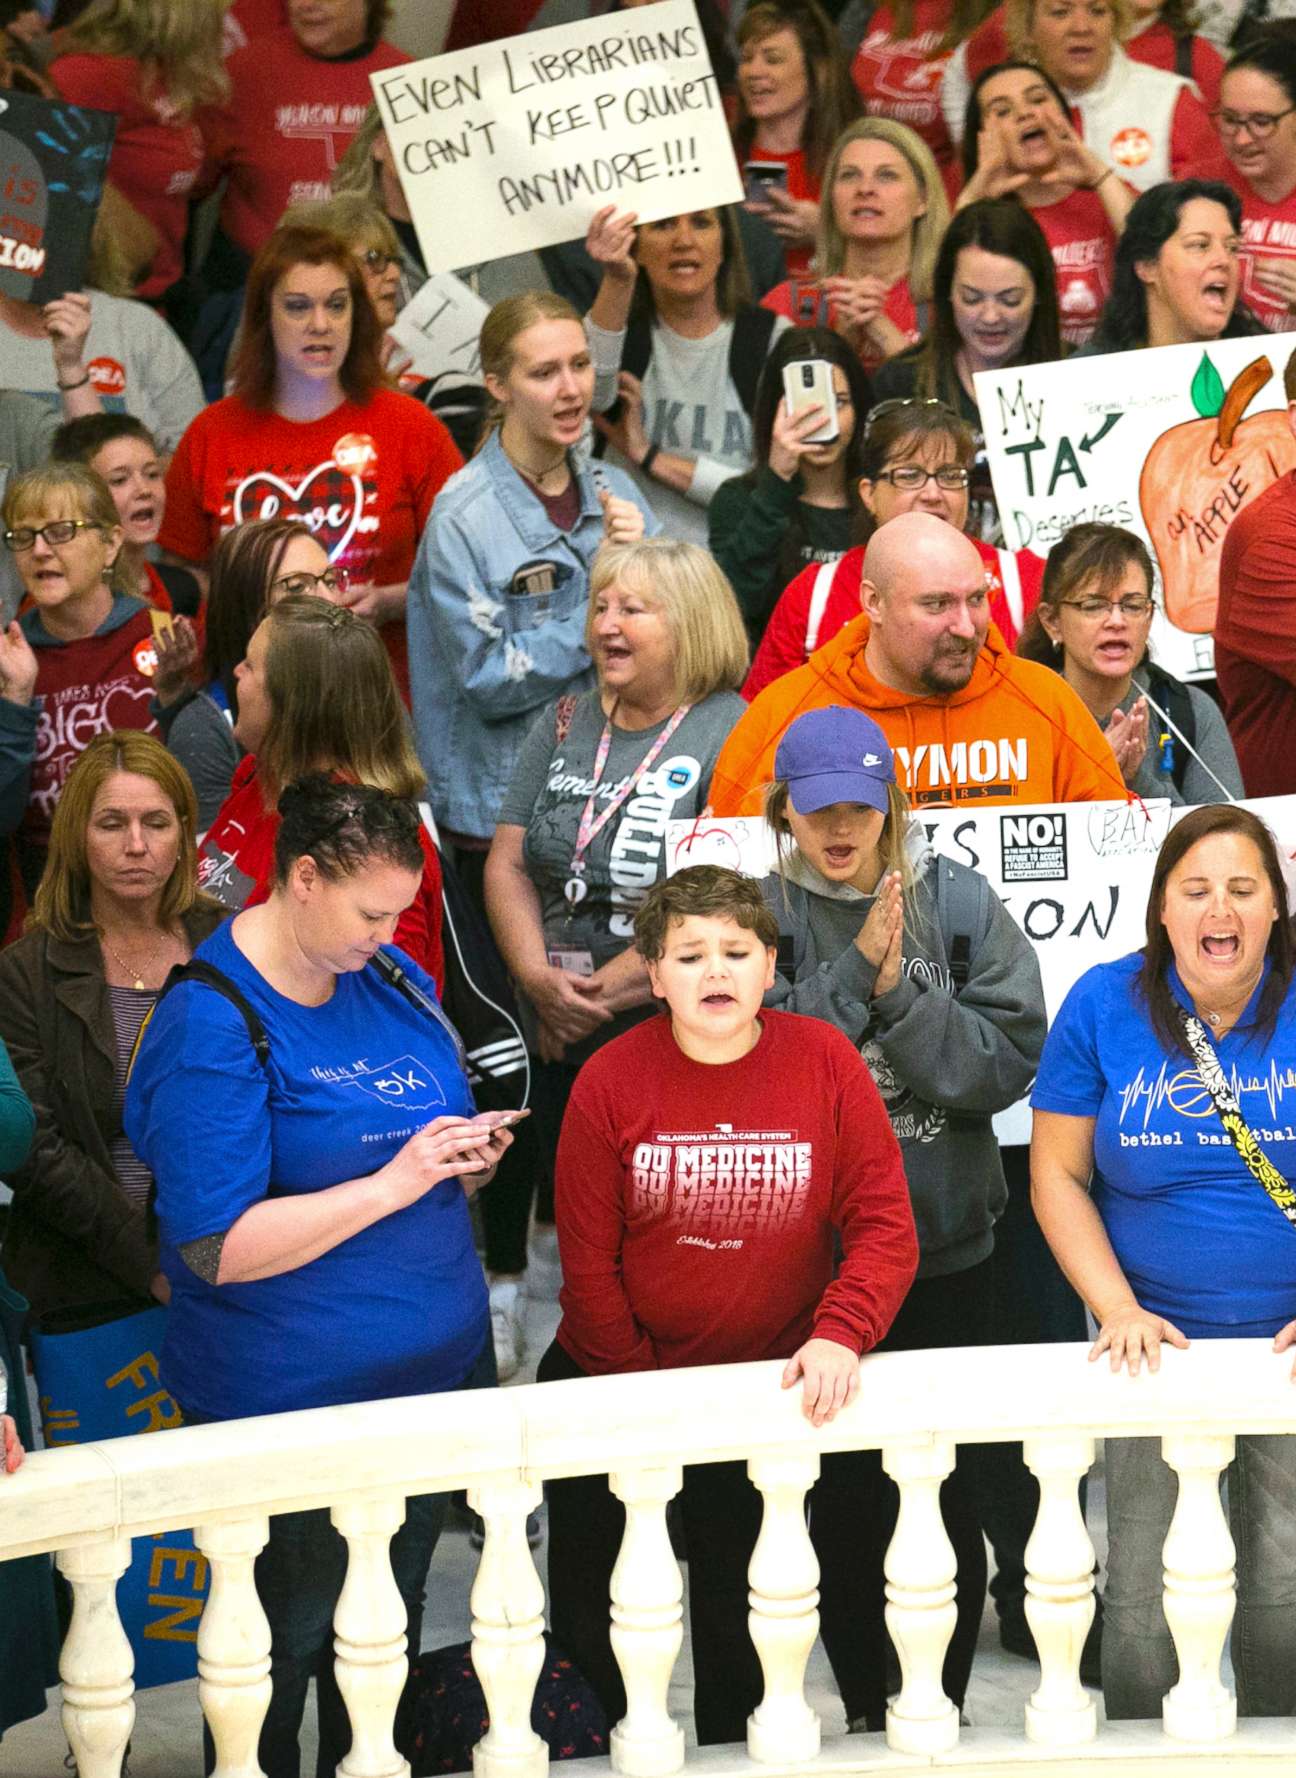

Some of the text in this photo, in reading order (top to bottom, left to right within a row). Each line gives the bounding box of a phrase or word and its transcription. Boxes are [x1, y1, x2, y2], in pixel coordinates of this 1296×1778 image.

[403, 120, 496, 176] CAN'T
[498, 137, 701, 216] ANYMORE!!!
[642, 399, 748, 452] KLA
[997, 379, 1044, 442] My
[1004, 436, 1088, 497] TA
[1193, 464, 1250, 553] APPLE
[135, 650, 159, 667] OE
[891, 738, 1028, 789] YMON
[919, 786, 990, 803] GERS
[1002, 815, 1064, 847] NO!
[1001, 885, 1120, 941] ON
[374, 1069, 427, 1096] OK
[387, 1128, 412, 1139] creek
[656, 1133, 707, 1142] OKLAHOMA'S
[708, 1133, 738, 1141] HEALTH
[761, 1132, 791, 1140] SYSTEM
[1119, 1131, 1184, 1148] bethel
[633, 1143, 813, 1173] OU MEDICINE
[673, 1170, 812, 1195] MEDICINE
